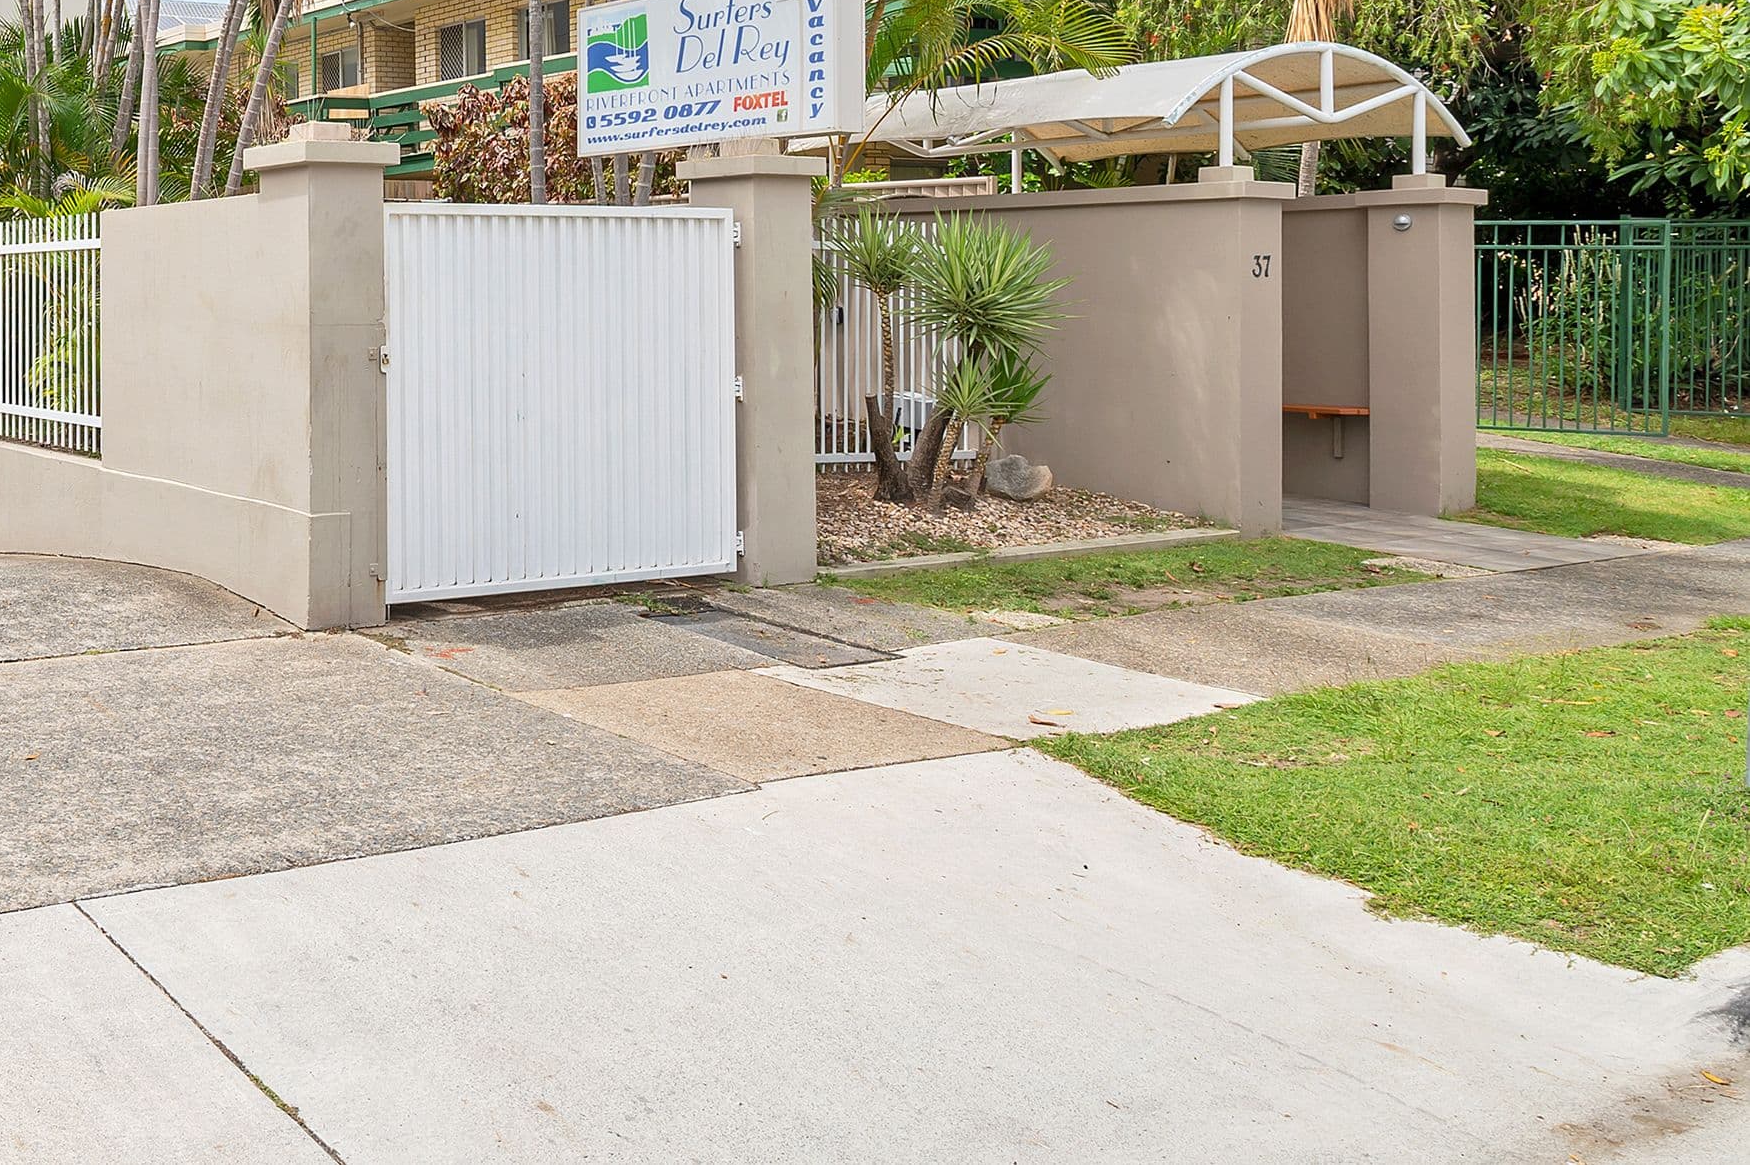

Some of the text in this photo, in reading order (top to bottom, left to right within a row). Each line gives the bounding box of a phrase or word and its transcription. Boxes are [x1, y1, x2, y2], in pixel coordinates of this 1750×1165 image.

[676, 25, 790, 73] Del Rey
[586, 71, 790, 112] RIVERFRONT APARTMENTS
[733, 90, 789, 112] FOXTEL
[600, 100, 721, 128] 5592 0877
[587, 116, 767, 144] www.surfersdelrey.com
[1252, 254, 1271, 278] 37
